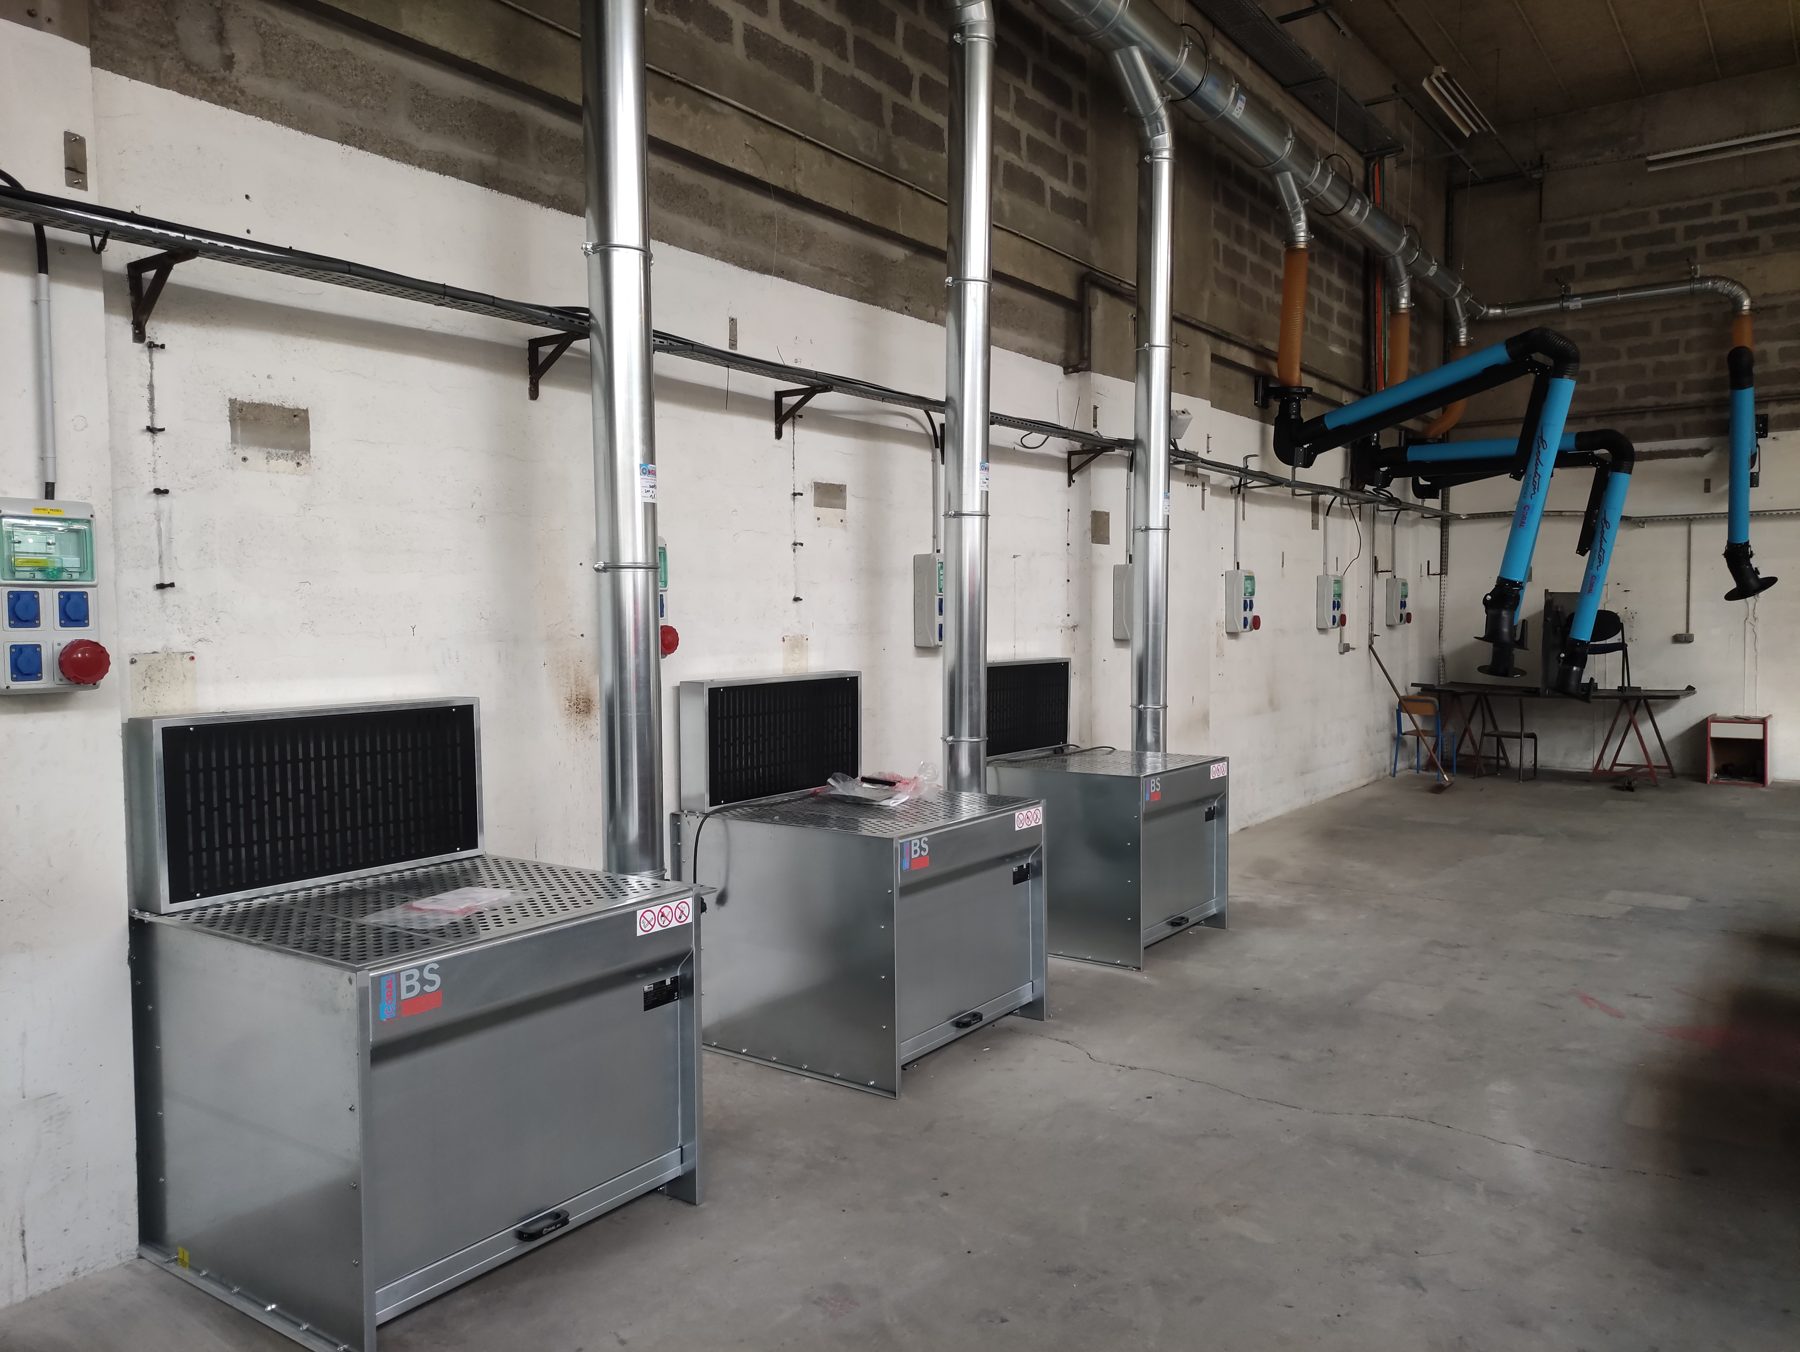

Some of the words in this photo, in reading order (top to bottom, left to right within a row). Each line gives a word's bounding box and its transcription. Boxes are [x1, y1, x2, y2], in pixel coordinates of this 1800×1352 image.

[1151, 777, 1160, 792] BS
[911, 837, 928, 858] BS
[401, 963, 441, 1000] BS
